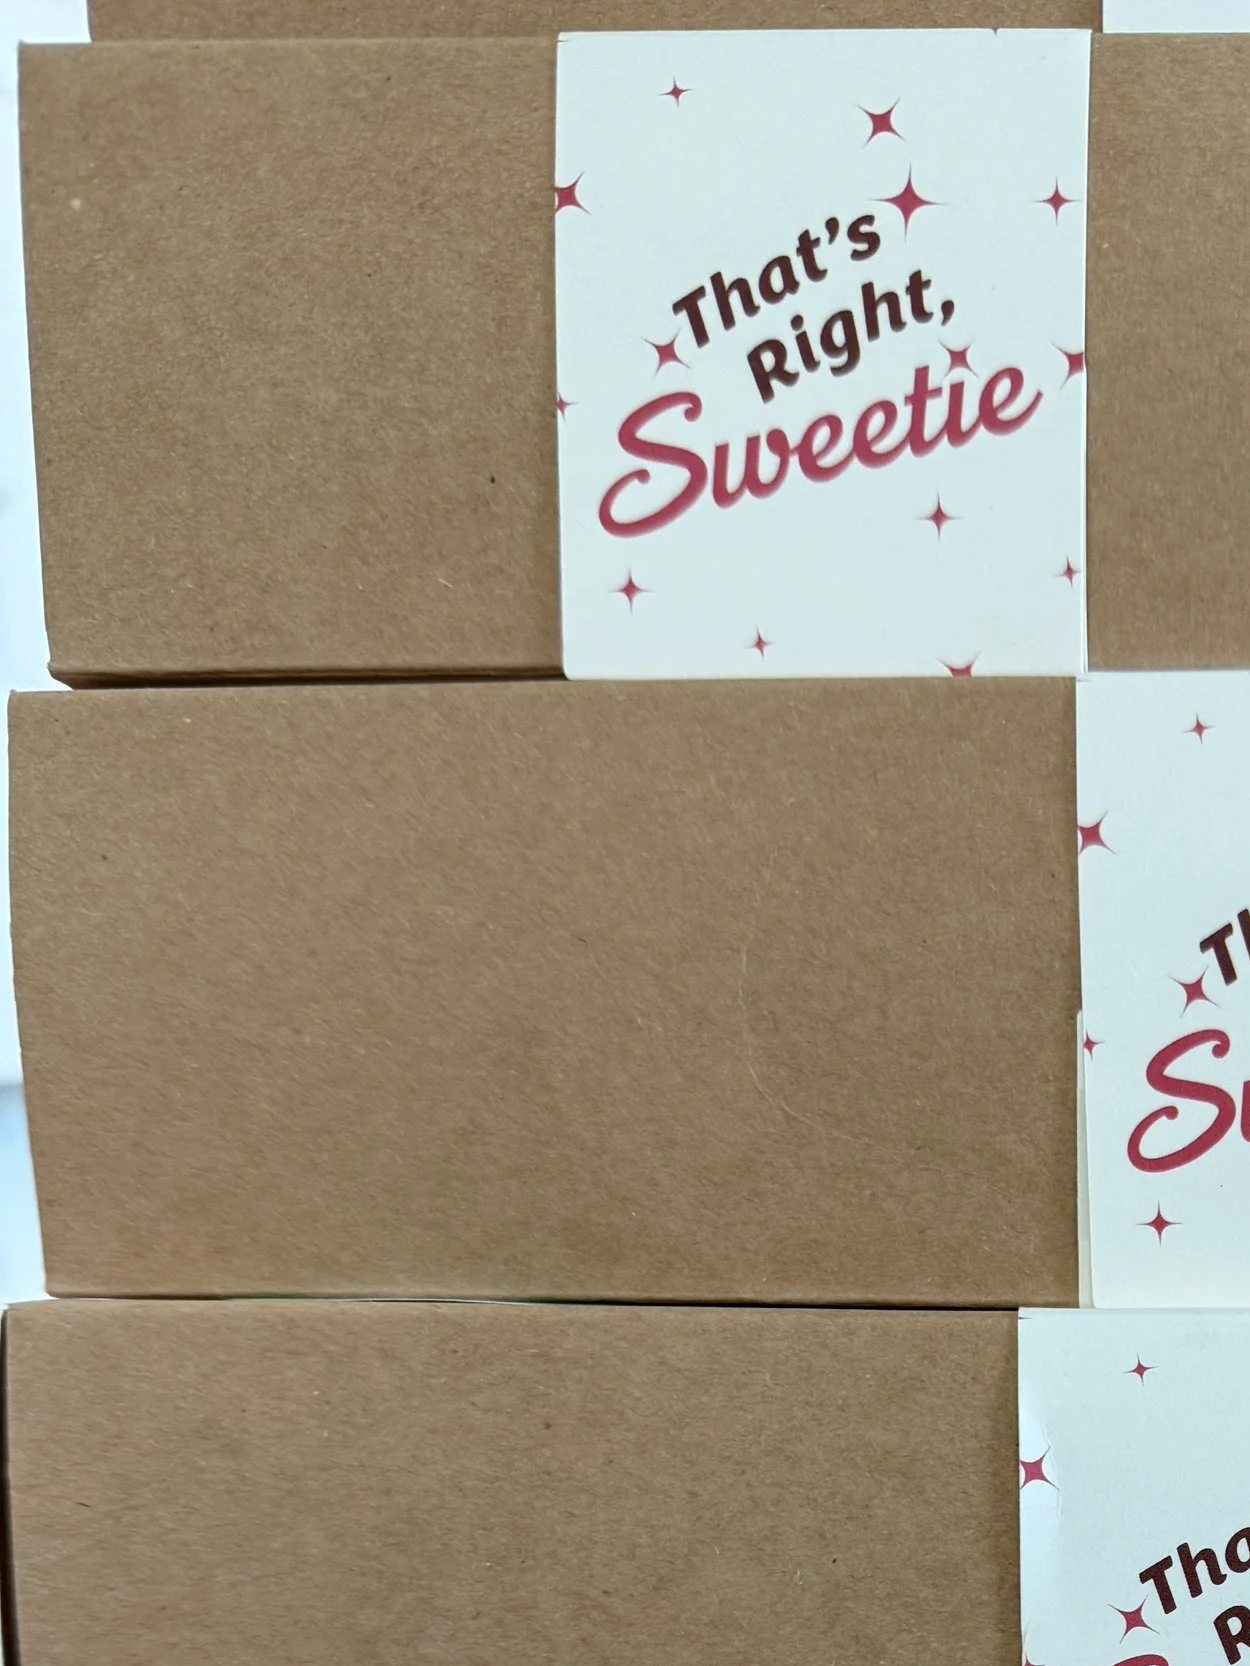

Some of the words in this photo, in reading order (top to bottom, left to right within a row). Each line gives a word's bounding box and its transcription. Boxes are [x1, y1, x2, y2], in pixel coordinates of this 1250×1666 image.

[672, 214, 881, 348] That's
[746, 269, 955, 403] Right,
[598, 365, 1043, 537] Sweetie
